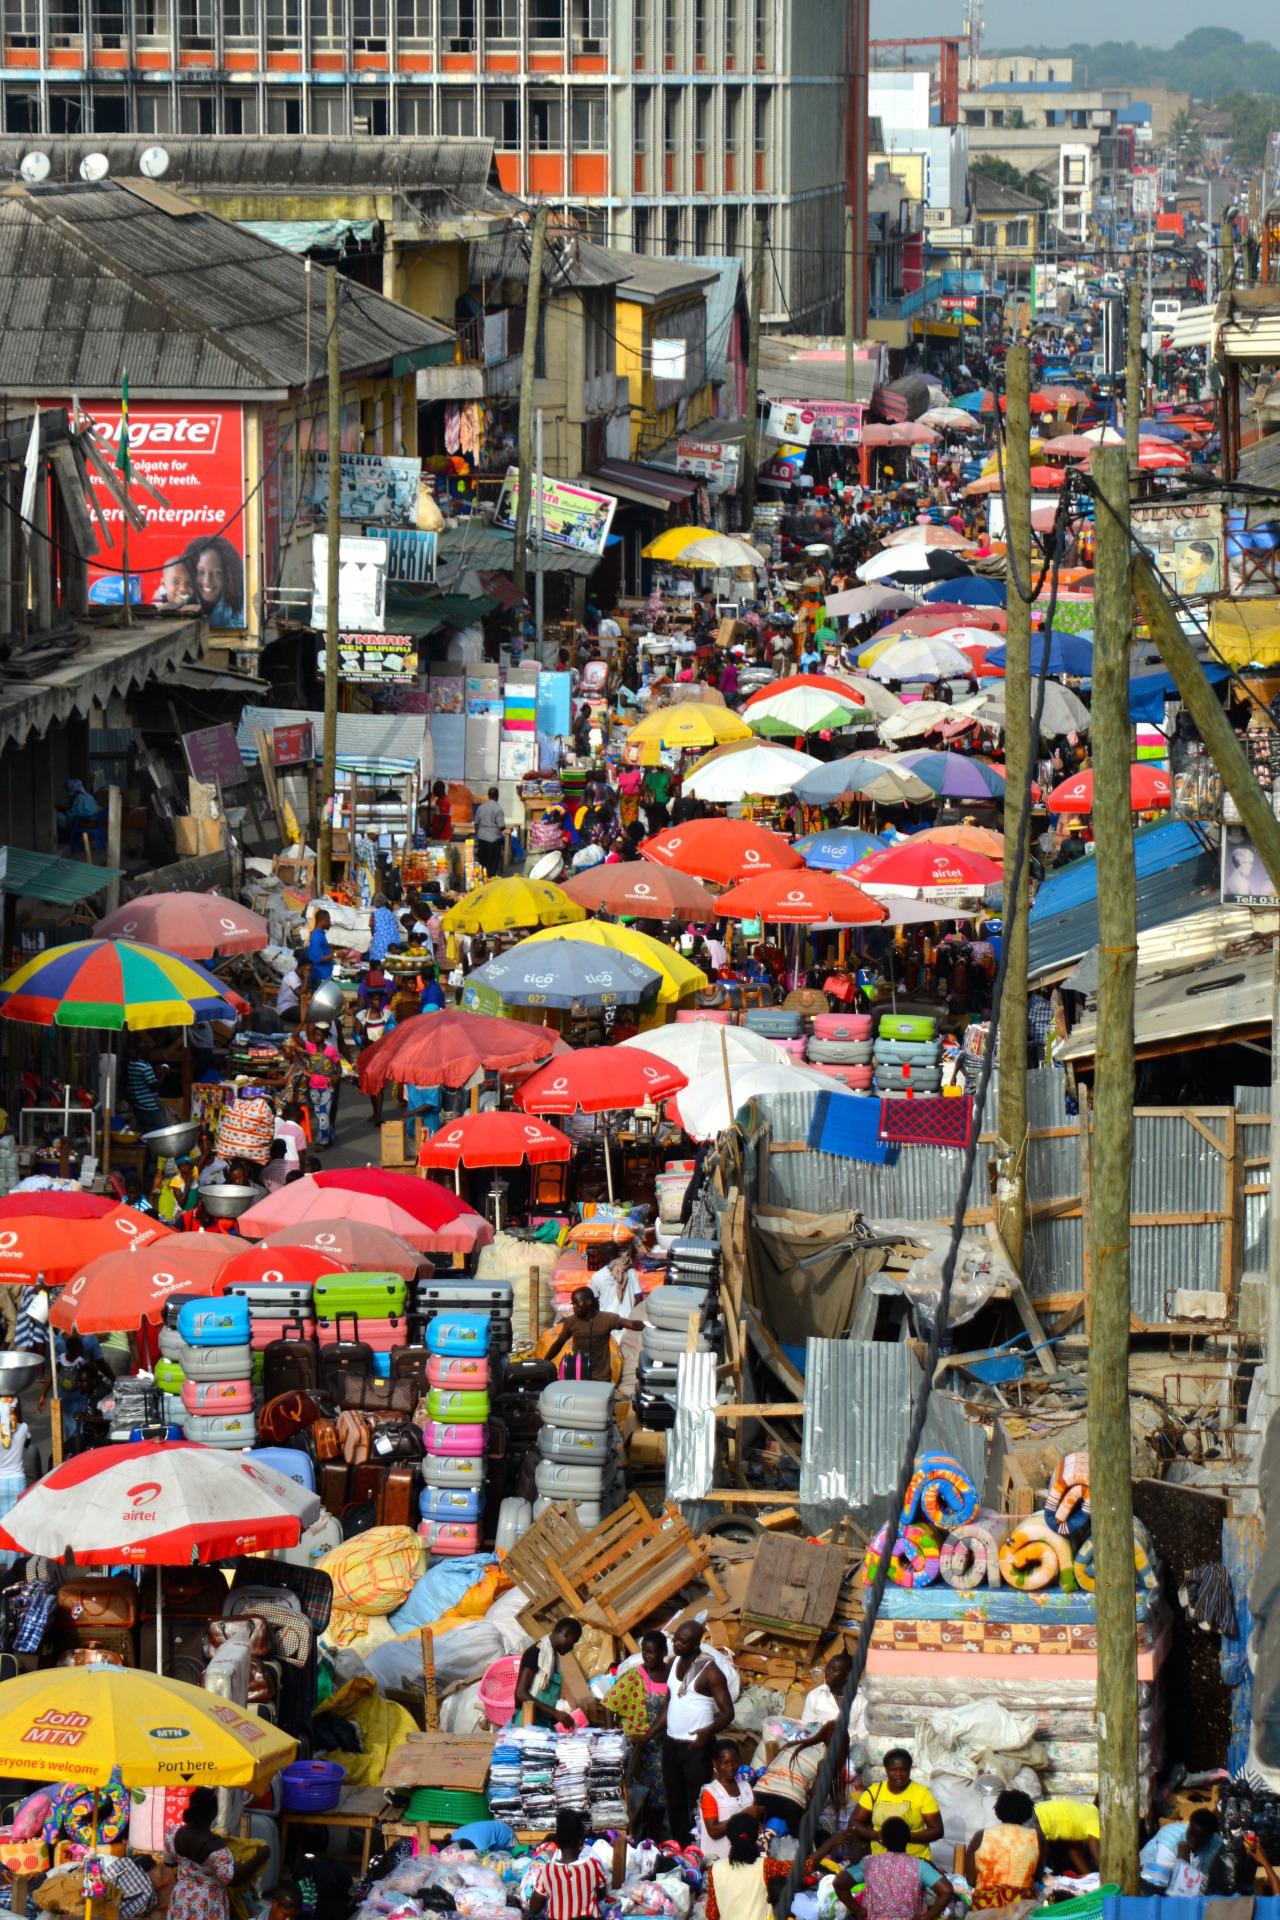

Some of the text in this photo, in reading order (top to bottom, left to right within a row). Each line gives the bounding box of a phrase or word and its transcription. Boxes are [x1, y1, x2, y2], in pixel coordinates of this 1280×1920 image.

[171, 459, 188, 471] for
[317, 453, 383, 467] DBERTA
[771, 464, 790, 478] LG
[169, 474, 200, 486] teeth.
[932, 869, 962, 879] airtel
[624, 893, 658, 901] vodafone
[1234, 895, 1257, 904] Tel:
[776, 900, 814, 908] vodafone
[524, 973, 554, 988] tigo
[585, 971, 613, 987] tigo
[528, 993, 547, 1005] 027
[151, 1278, 193, 1299] vodafone
[122, 1510, 157, 1522] airtel
[35, 1708, 89, 1727] Join
[23, 1727, 82, 1746] MTN
[156, 1727, 183, 1738] MTN
[48, 1761, 100, 1776] welcome
[157, 1758, 218, 1772] Port here.
